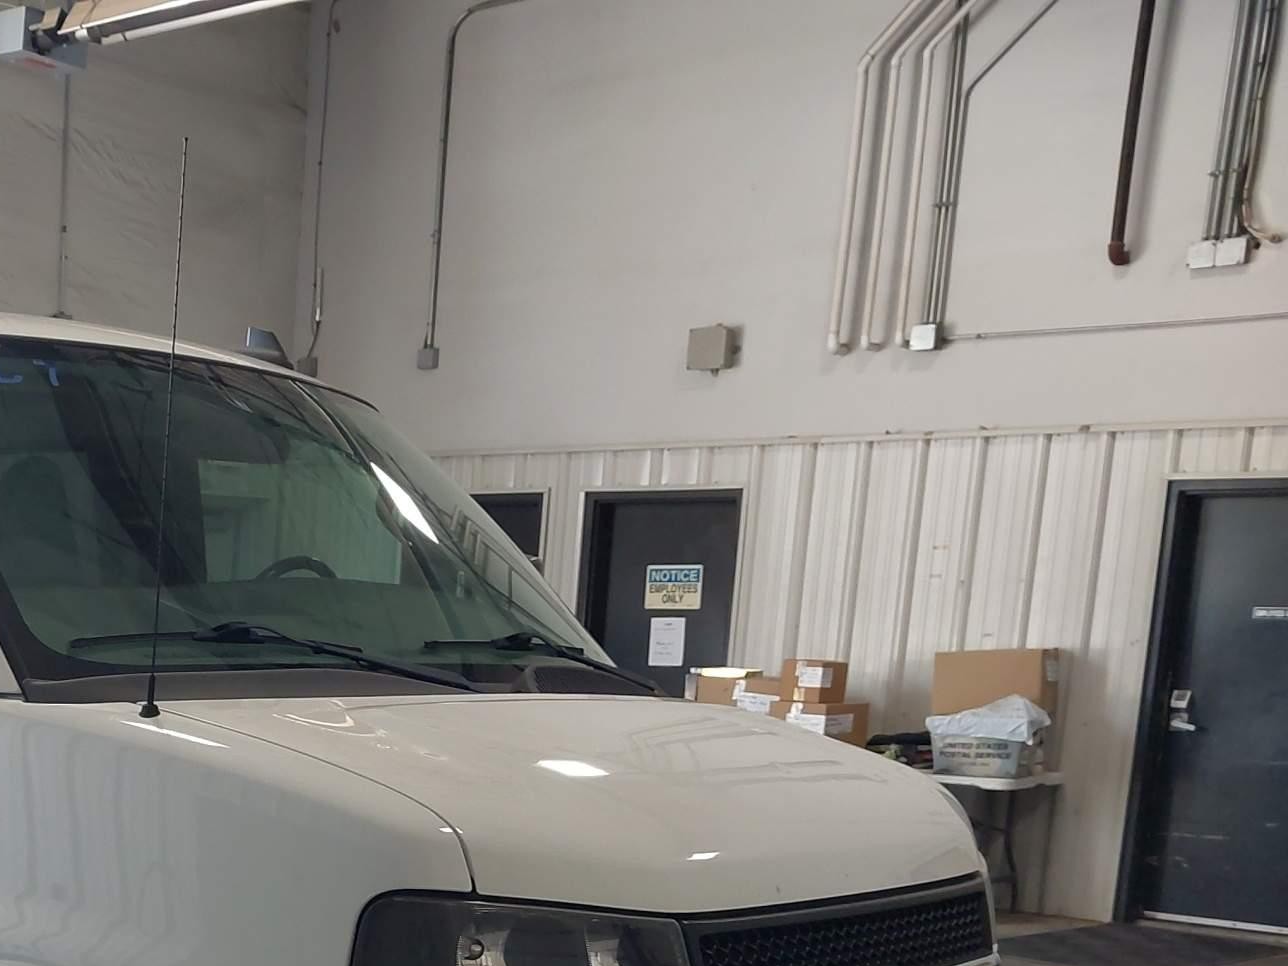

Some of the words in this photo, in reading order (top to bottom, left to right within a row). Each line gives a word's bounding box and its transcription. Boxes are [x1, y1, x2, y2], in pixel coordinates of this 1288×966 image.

[651, 570, 698, 581] NOTICE
[649, 584, 698, 593] EMPLOYEES
[662, 594, 683, 604] ONLY
[939, 751, 971, 759] POSTAL
